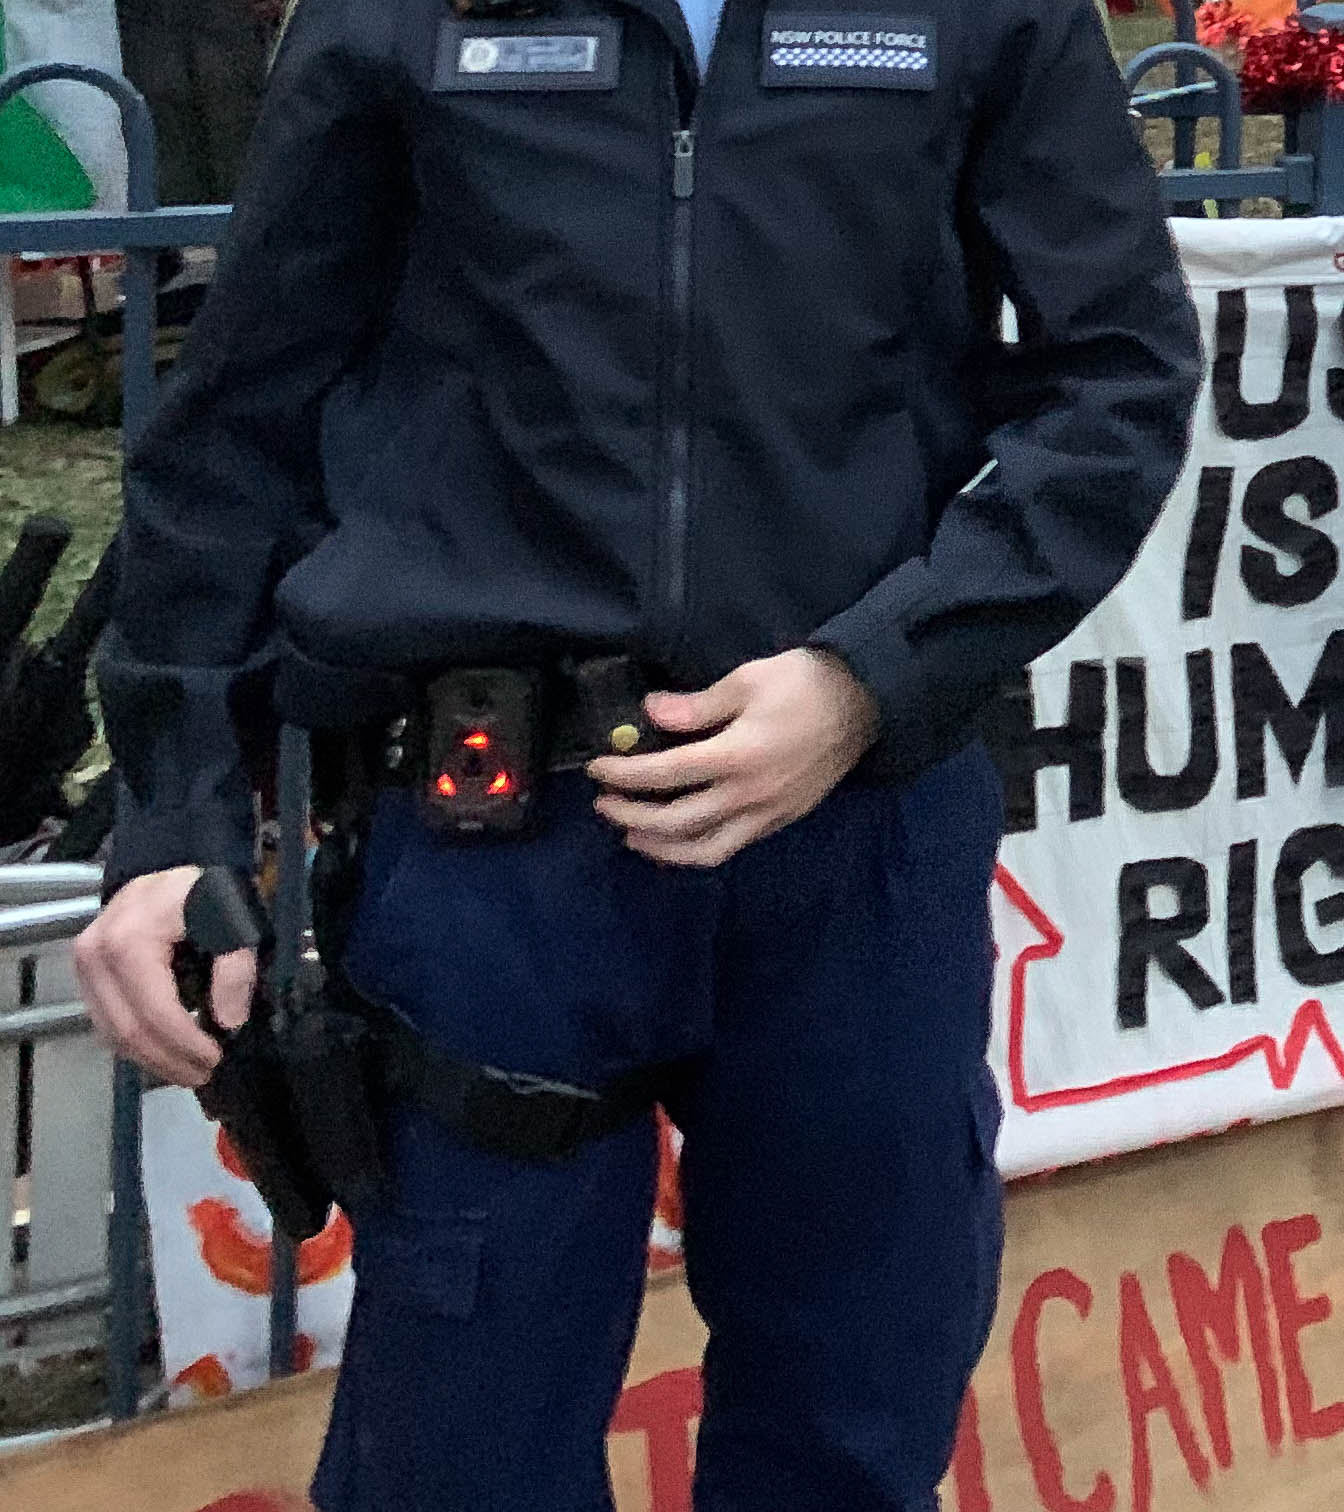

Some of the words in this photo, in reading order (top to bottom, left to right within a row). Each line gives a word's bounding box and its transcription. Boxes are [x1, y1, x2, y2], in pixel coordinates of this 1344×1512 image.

[814, 30, 872, 45] POLICE
[875, 31, 927, 48] FORCE
[1181, 454, 1339, 620] IS
